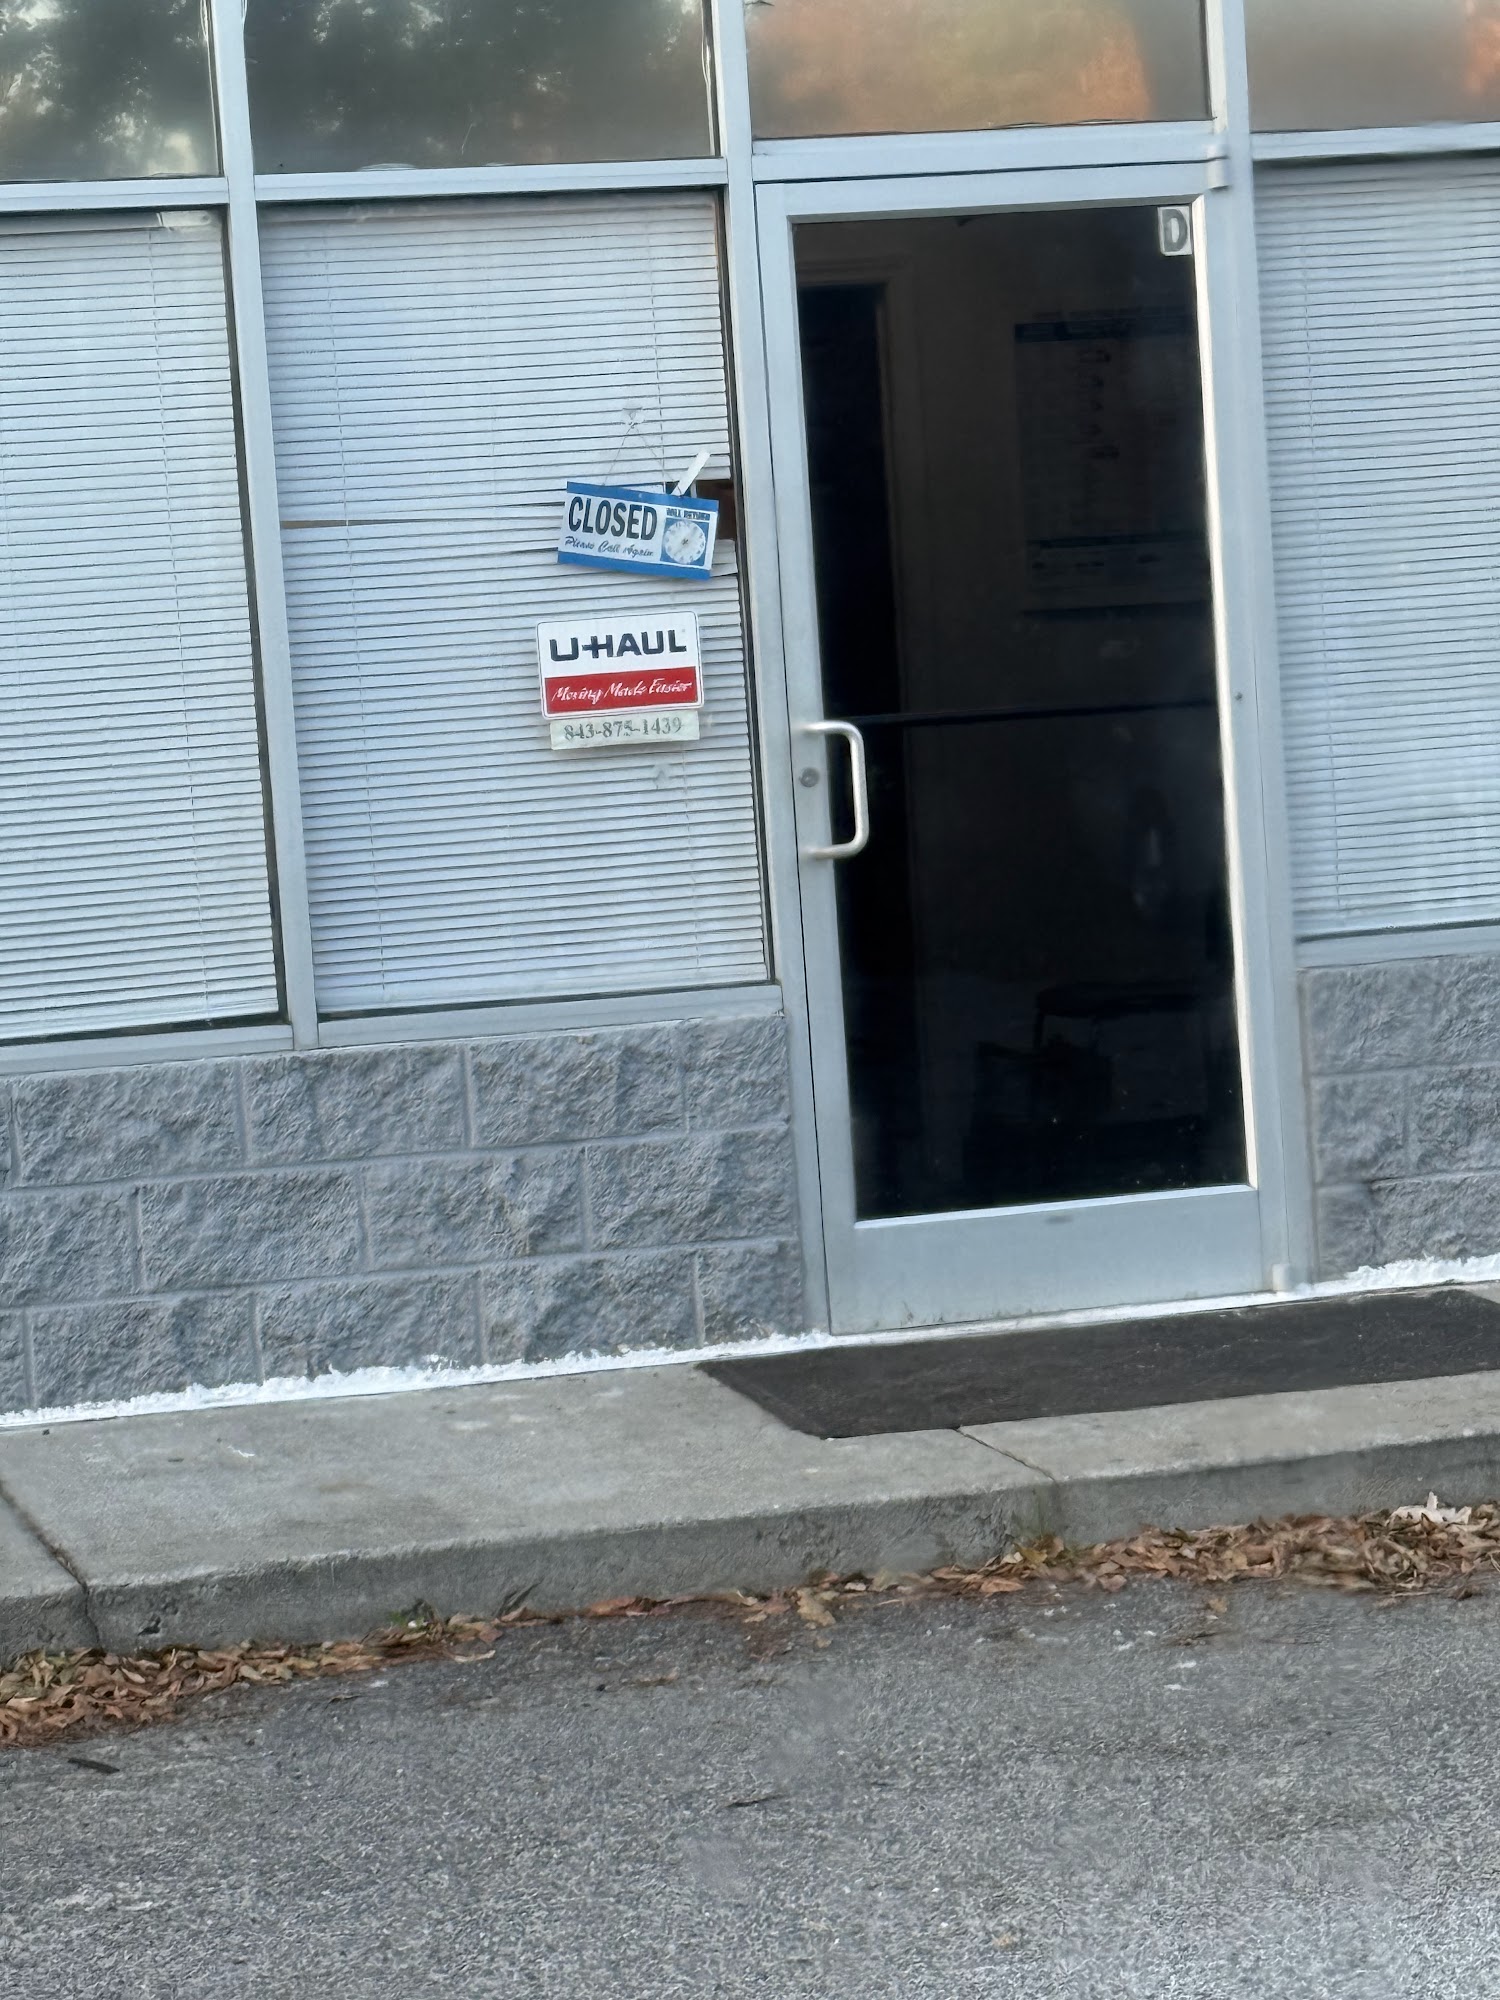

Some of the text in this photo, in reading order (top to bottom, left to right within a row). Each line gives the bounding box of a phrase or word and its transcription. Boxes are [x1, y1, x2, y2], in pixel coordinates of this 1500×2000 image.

[1161, 208, 1188, 253] D
[568, 496, 658, 541] CLOSED
[565, 535, 654, 558] Please Call Again
[549, 629, 687, 662] U-HAUL
[552, 678, 692, 705] Moving Made Easier
[564, 716, 682, 741] 843-875-1439
